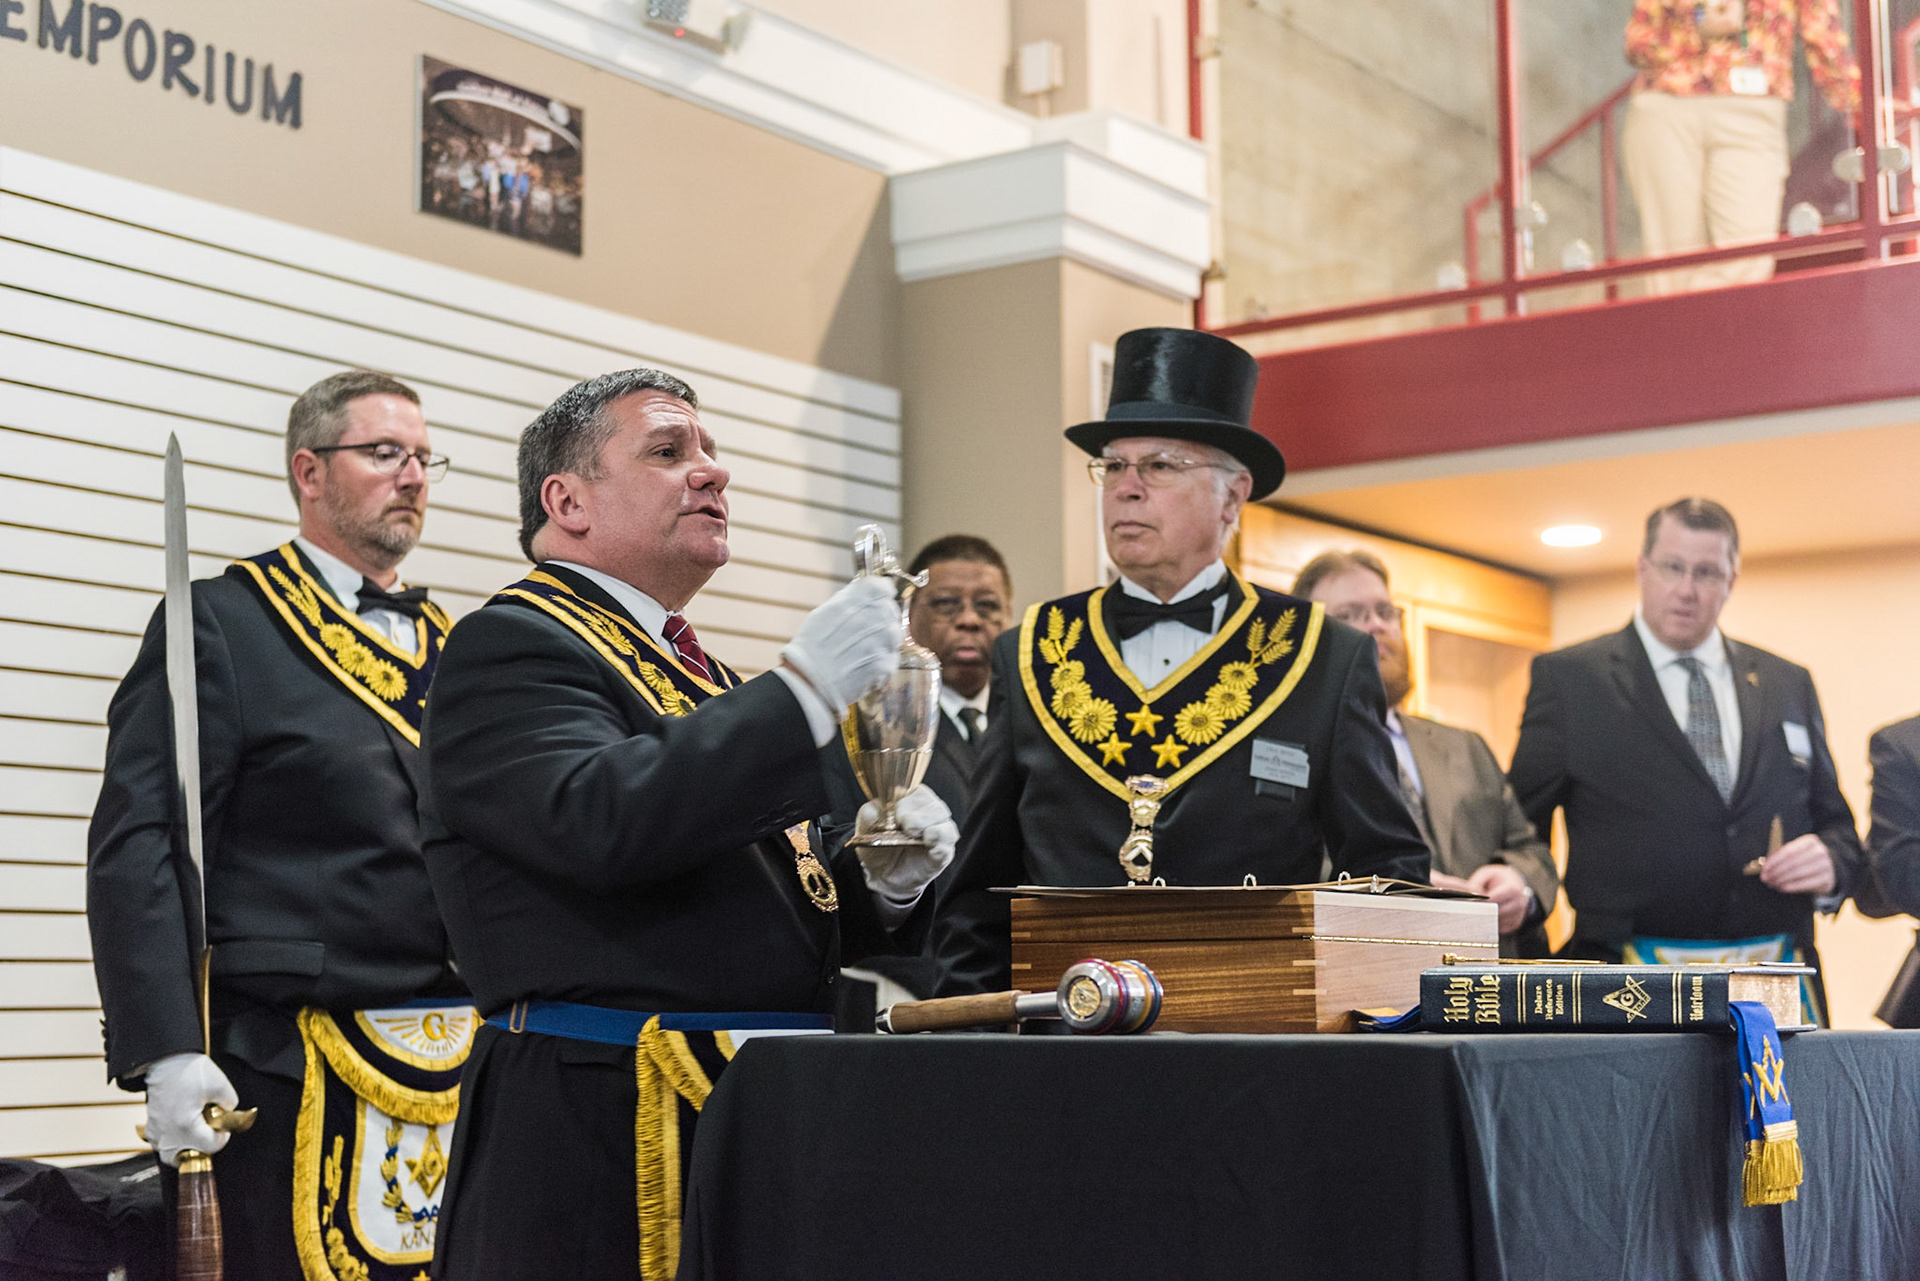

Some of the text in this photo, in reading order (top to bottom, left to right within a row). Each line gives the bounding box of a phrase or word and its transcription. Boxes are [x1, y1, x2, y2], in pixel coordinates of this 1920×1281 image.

[0, 0, 304, 129] EMPORIUM
[1443, 976, 1474, 1023] Holy
[1474, 974, 1501, 1025] Bible
[1534, 985, 1543, 1014] Deluxe
[1545, 978, 1554, 1020] Reference
[1555, 984, 1564, 1015] Edition
[1689, 975, 1704, 1021] Heirloom
[422, 1012, 450, 1041] G
[401, 1229, 436, 1250] KAN
